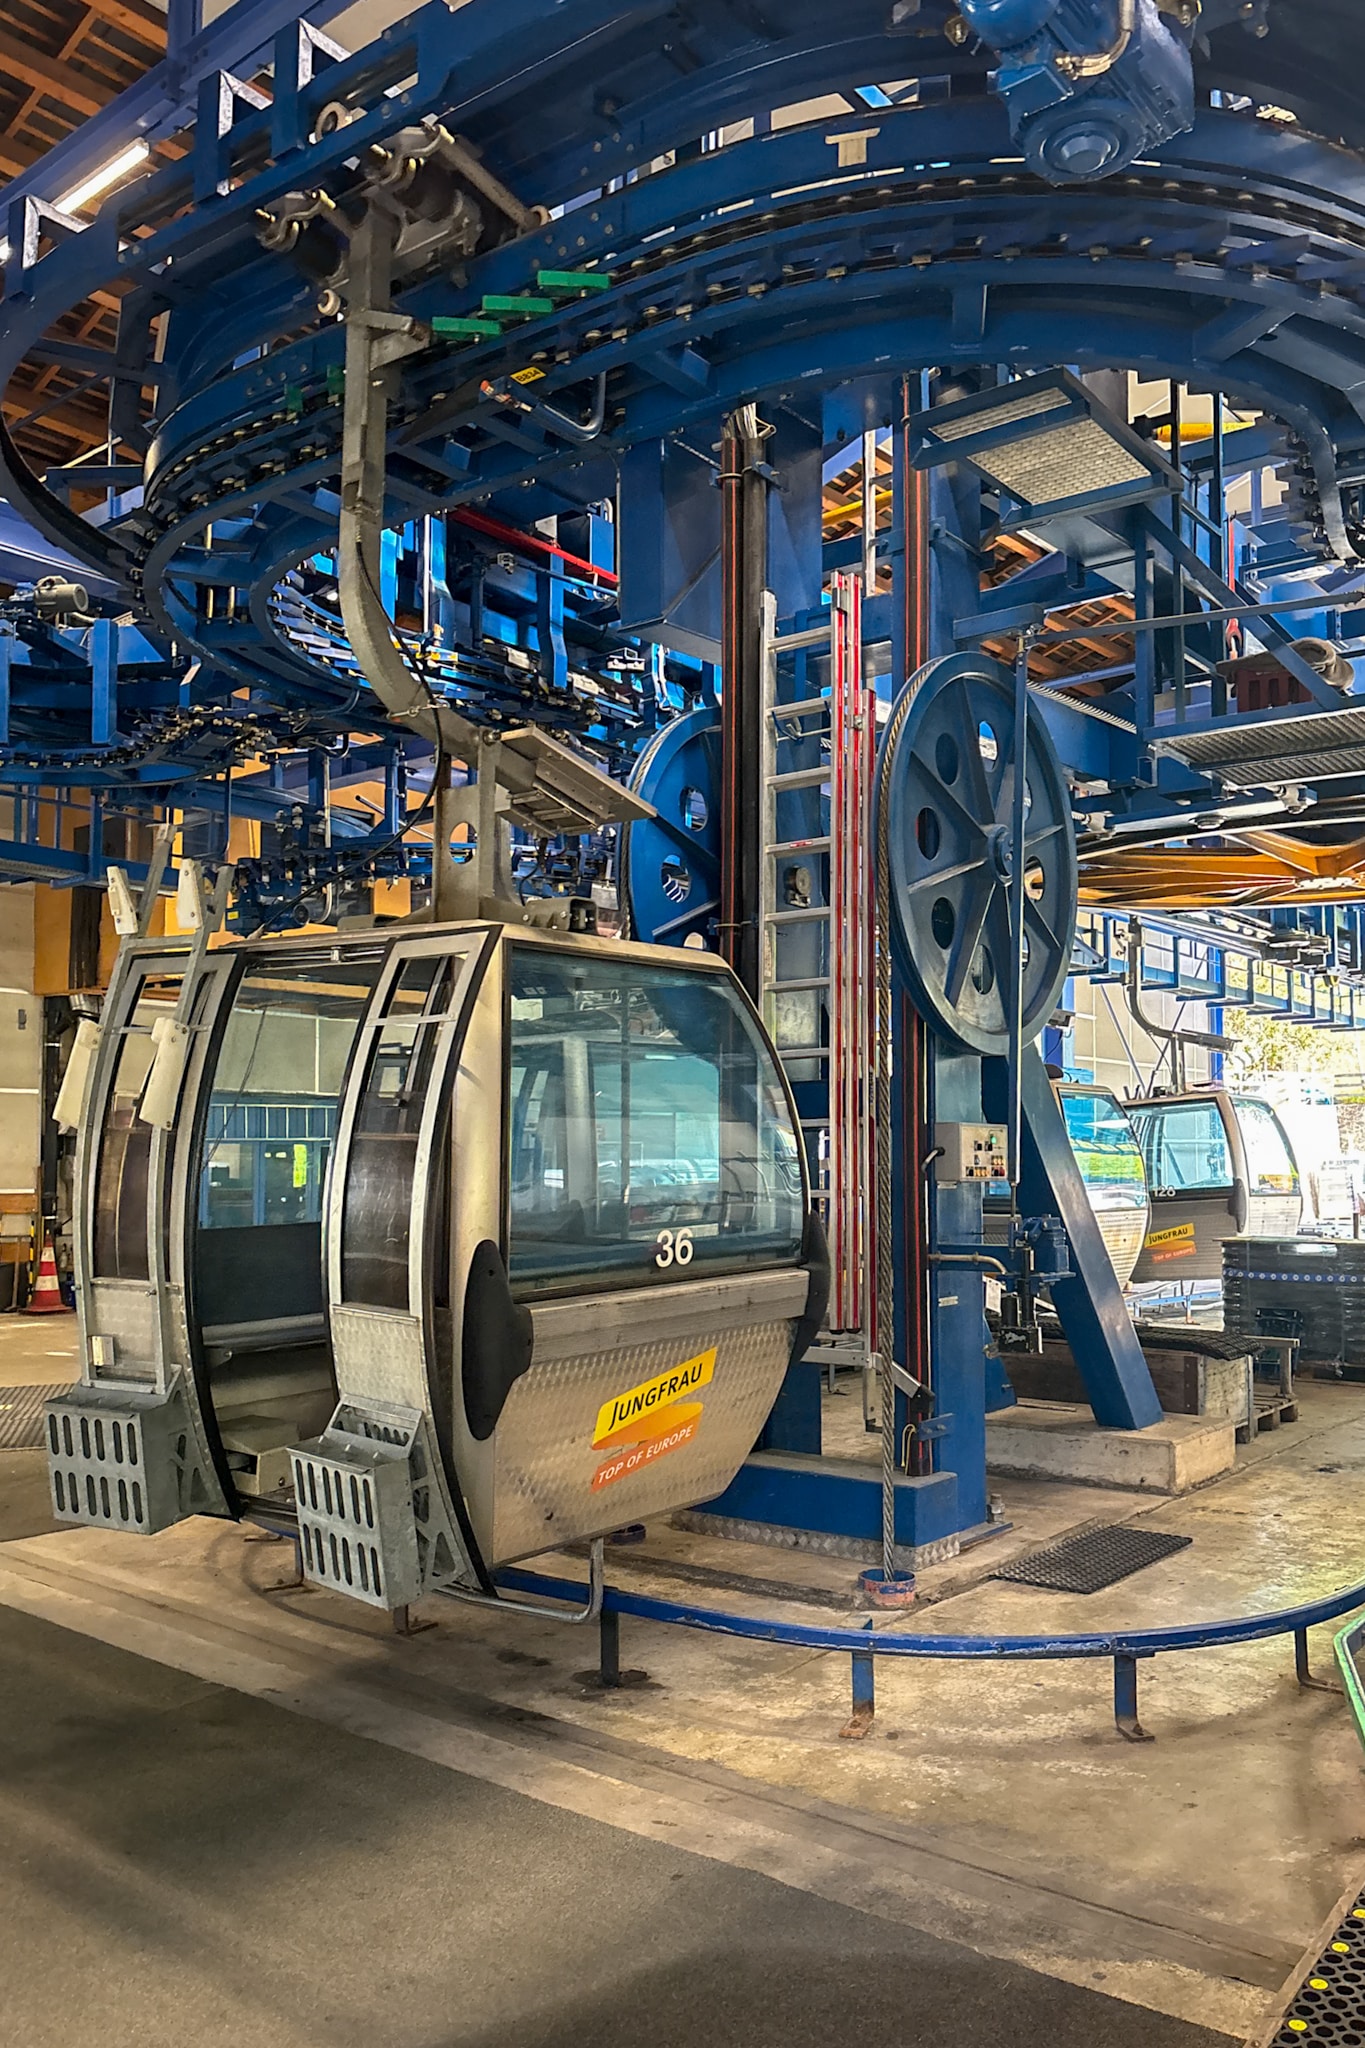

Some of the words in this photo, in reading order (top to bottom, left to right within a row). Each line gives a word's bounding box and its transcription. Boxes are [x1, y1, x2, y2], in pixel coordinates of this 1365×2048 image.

[1153, 1185, 1176, 1197] 128
[655, 1227, 694, 1268] 36
[1148, 1227, 1188, 1245] JUNGFRAU
[1154, 1254, 1164, 1262] TOP
[608, 1363, 702, 1431] JUNGFRAU
[598, 1462, 624, 1484] TOP
[626, 1450, 644, 1468] OF
[646, 1424, 694, 1459] EUROPE
